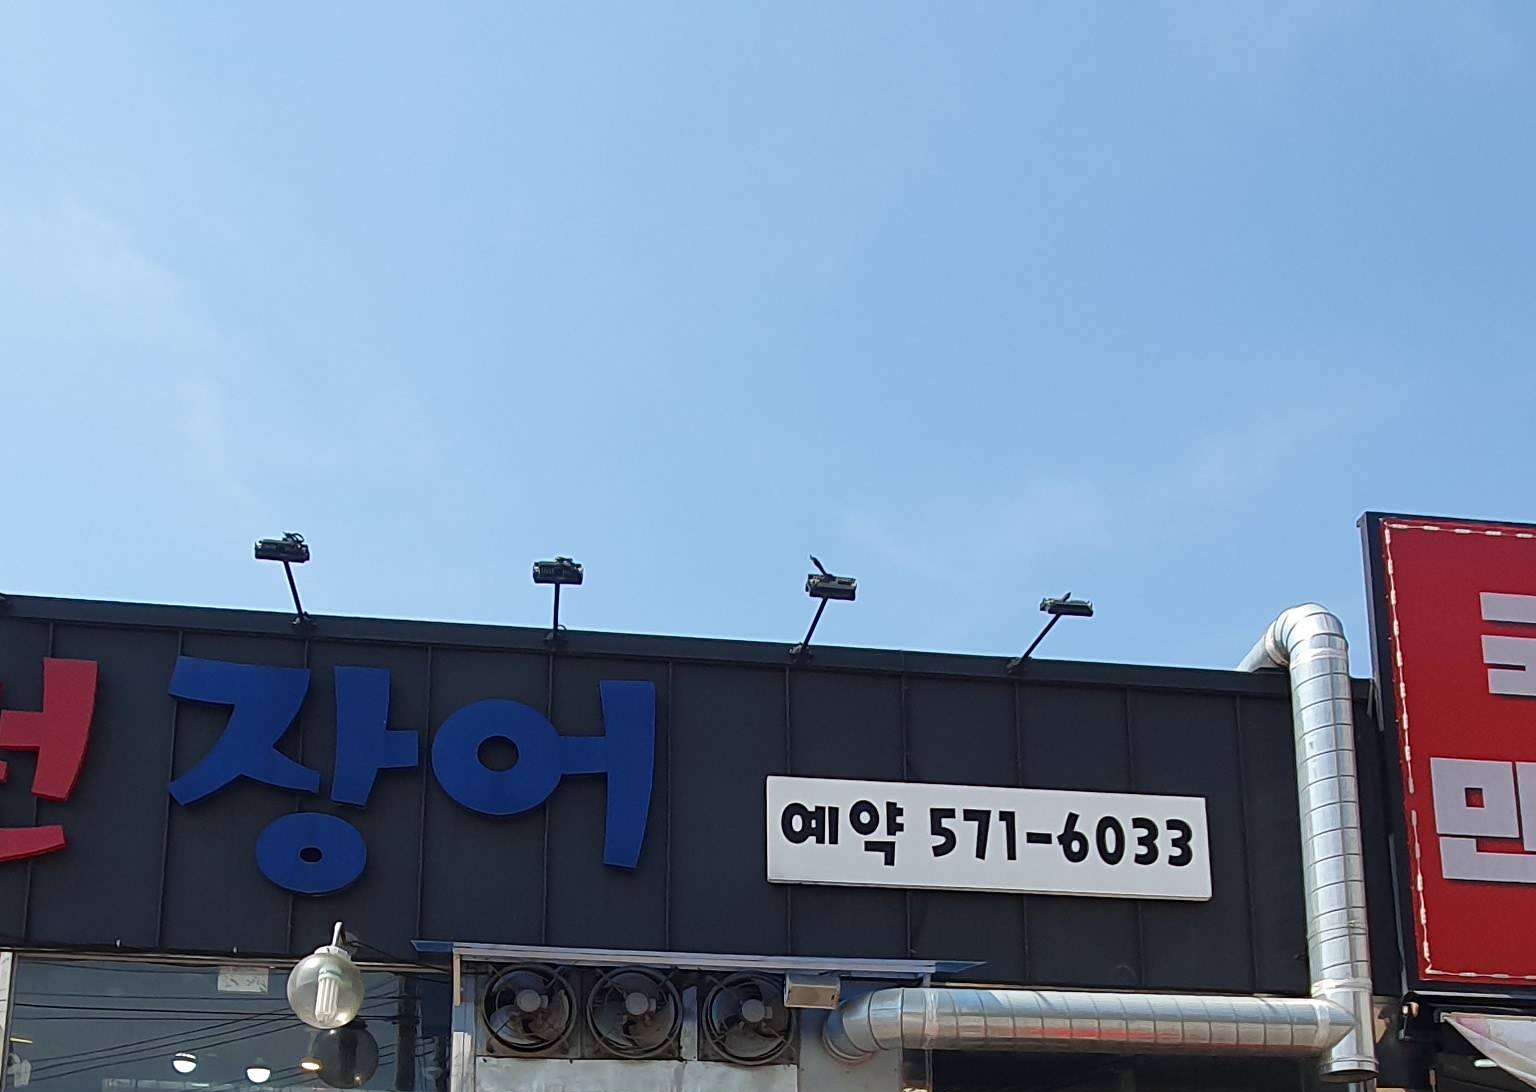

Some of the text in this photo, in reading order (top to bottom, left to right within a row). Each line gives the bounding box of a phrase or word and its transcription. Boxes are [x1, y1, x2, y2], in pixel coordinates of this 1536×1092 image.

[167, 655, 656, 897] 장어
[780, 800, 1194, 868] 예약 571-6033
